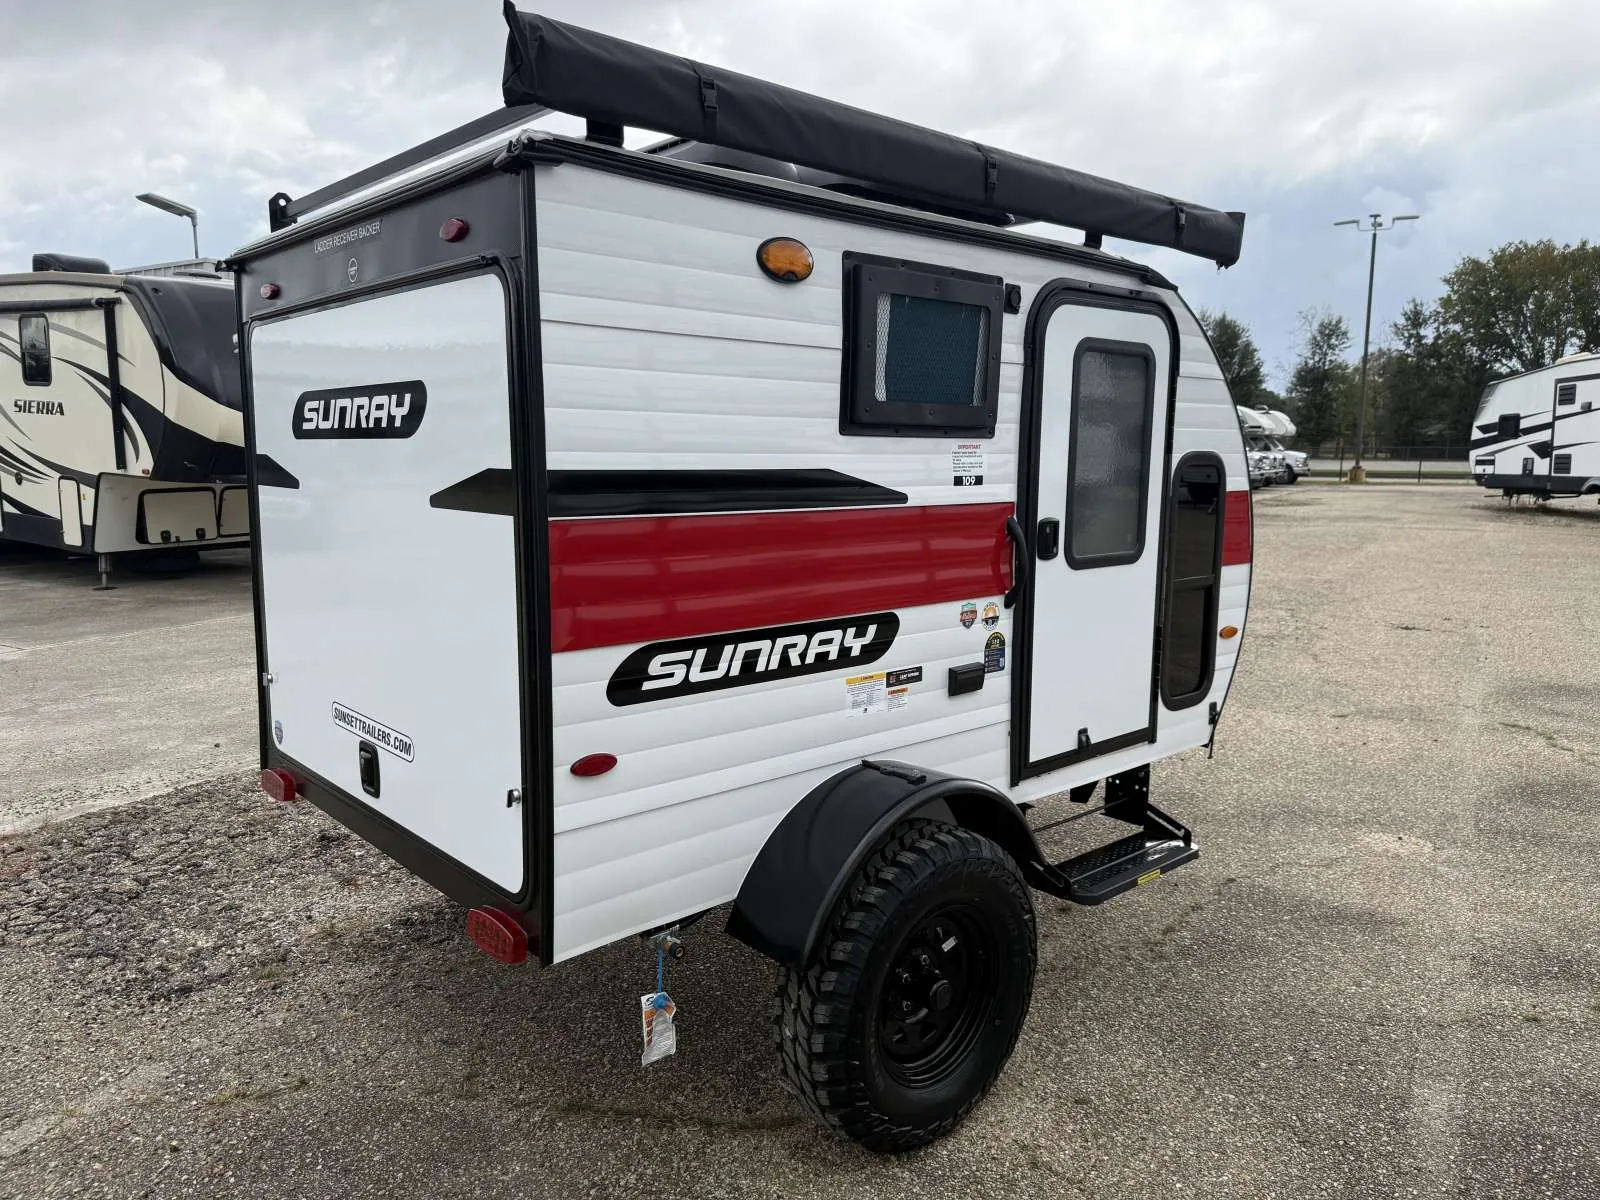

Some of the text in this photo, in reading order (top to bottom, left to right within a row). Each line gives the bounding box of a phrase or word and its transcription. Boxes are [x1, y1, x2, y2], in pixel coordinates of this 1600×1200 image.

[314, 221, 381, 254] LADDER RECEIVER BACKER
[13, 399, 65, 416] SIERRA
[302, 393, 412, 430] SUNRAY
[962, 476, 976, 486] 109
[641, 623, 878, 691] SUNRAY
[333, 706, 412, 757] SUNSETTRAILERS.COM
